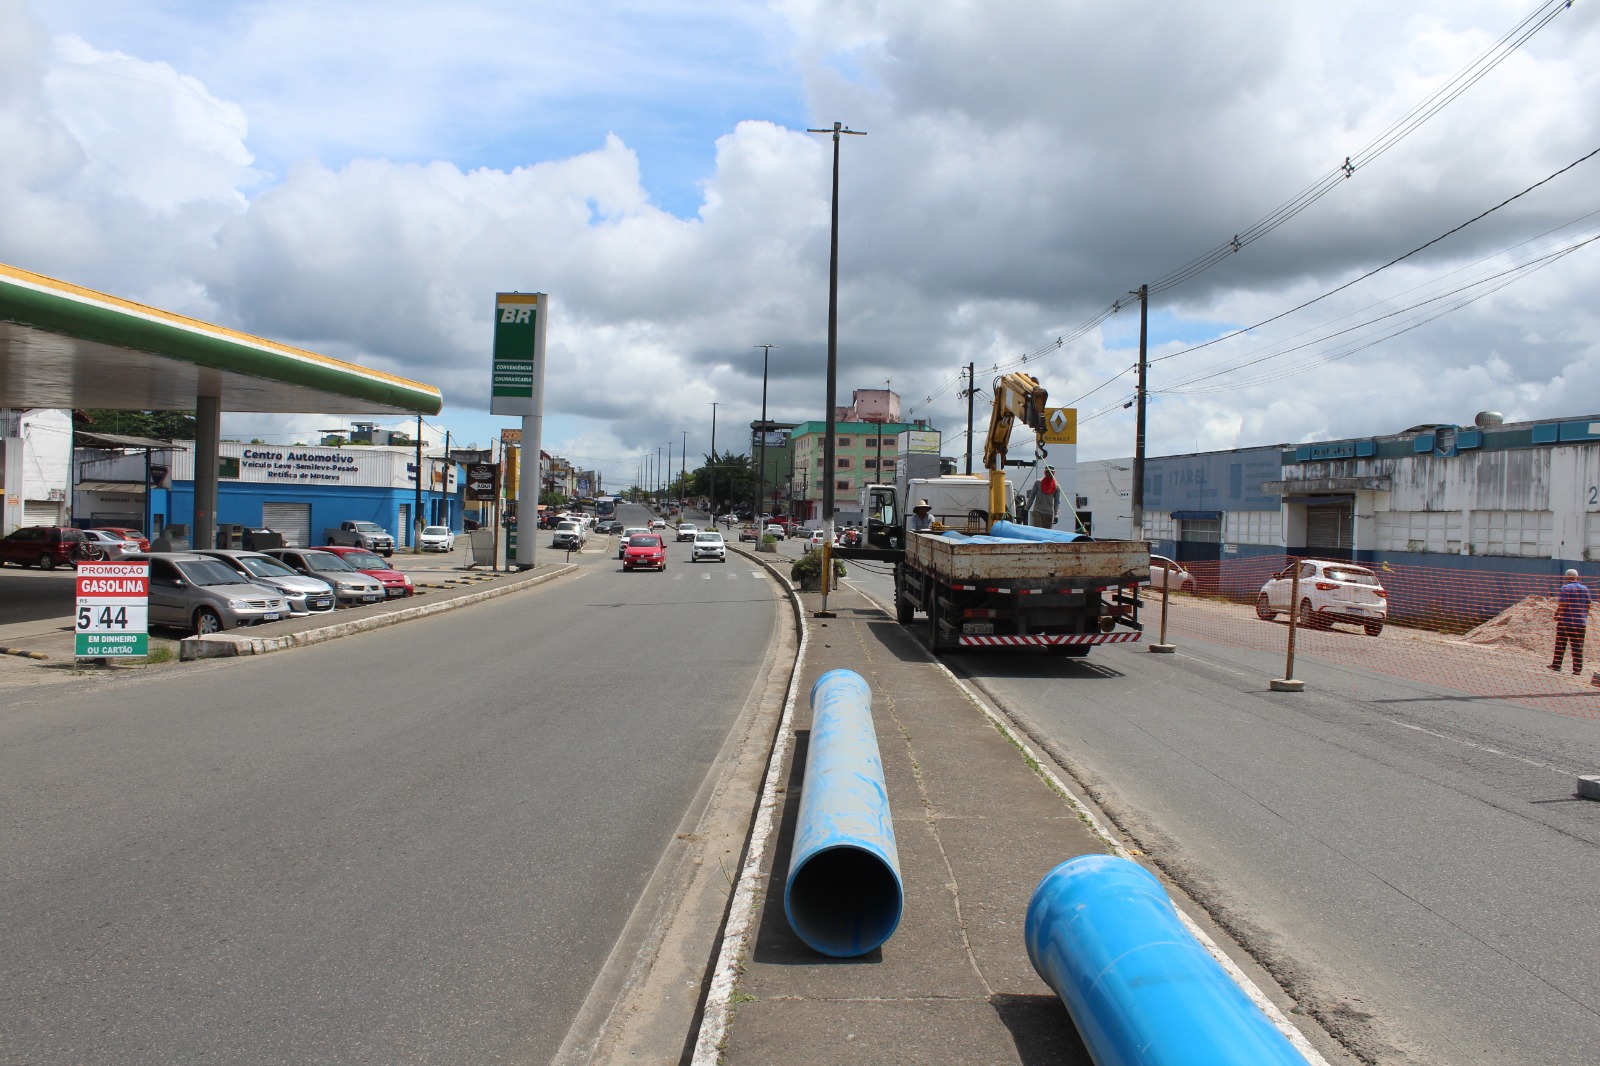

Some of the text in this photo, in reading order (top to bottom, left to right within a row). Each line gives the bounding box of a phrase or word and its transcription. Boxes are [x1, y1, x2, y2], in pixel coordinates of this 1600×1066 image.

[500, 306, 531, 323] BR
[243, 449, 354, 463] Centro Automotivo
[268, 470, 297, 479] Retífica
[1588, 485, 1598, 505] 2
[81, 566, 144, 576] PROMOÇÃO
[81, 580, 144, 592] GASOLINA
[88, 635, 138, 643] EM DINHEIRO
[102, 645, 133, 654] CARTÃO
